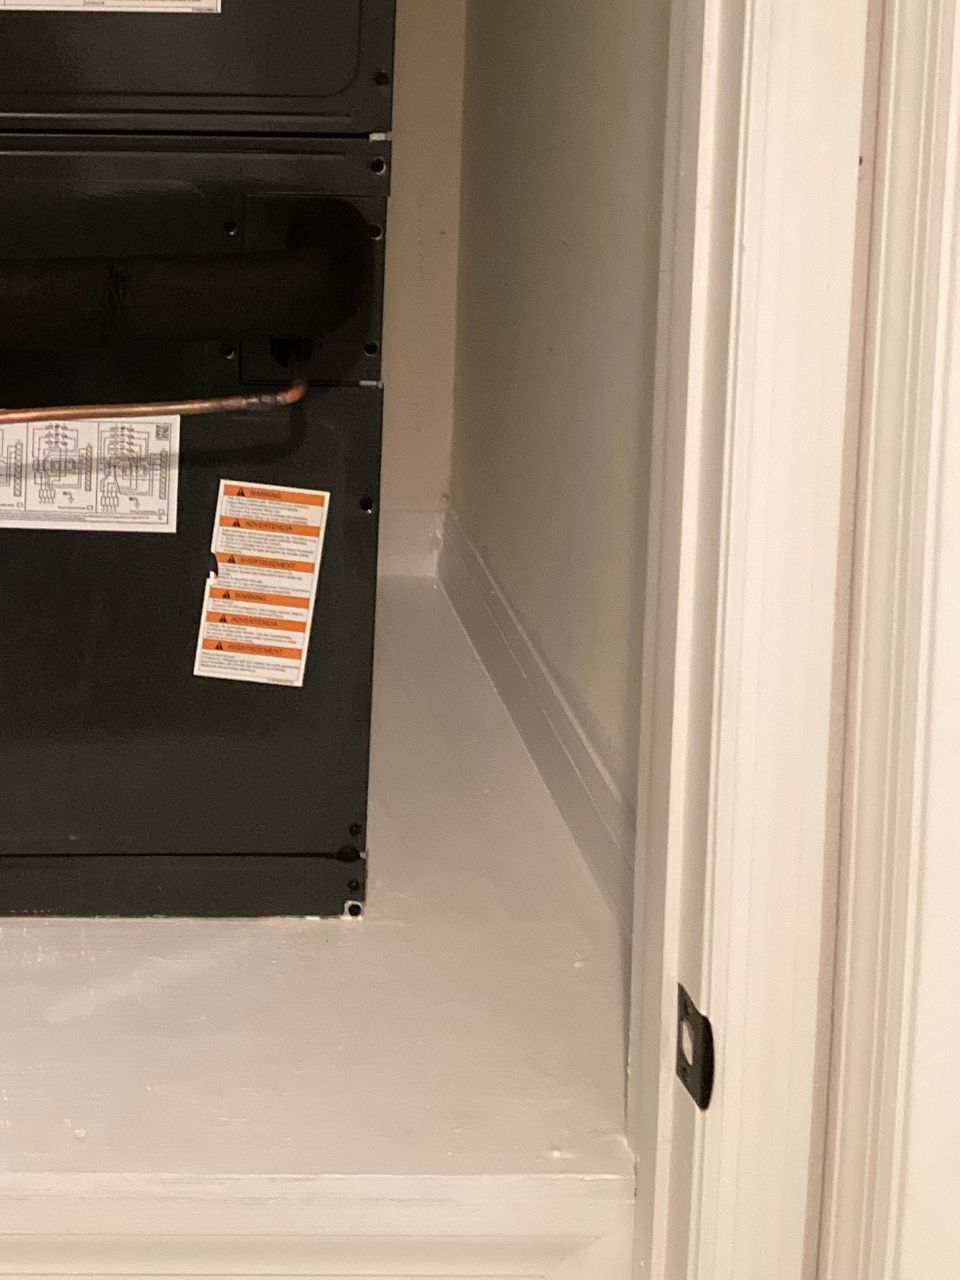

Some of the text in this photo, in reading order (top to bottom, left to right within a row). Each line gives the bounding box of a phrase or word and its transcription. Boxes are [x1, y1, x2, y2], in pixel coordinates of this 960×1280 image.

[248, 490, 281, 499] WARNING
[246, 521, 293, 531] ADVERTENCIA
[240, 557, 296, 569] AVERTISSEMENT
[234, 592, 266, 601] WARNING
